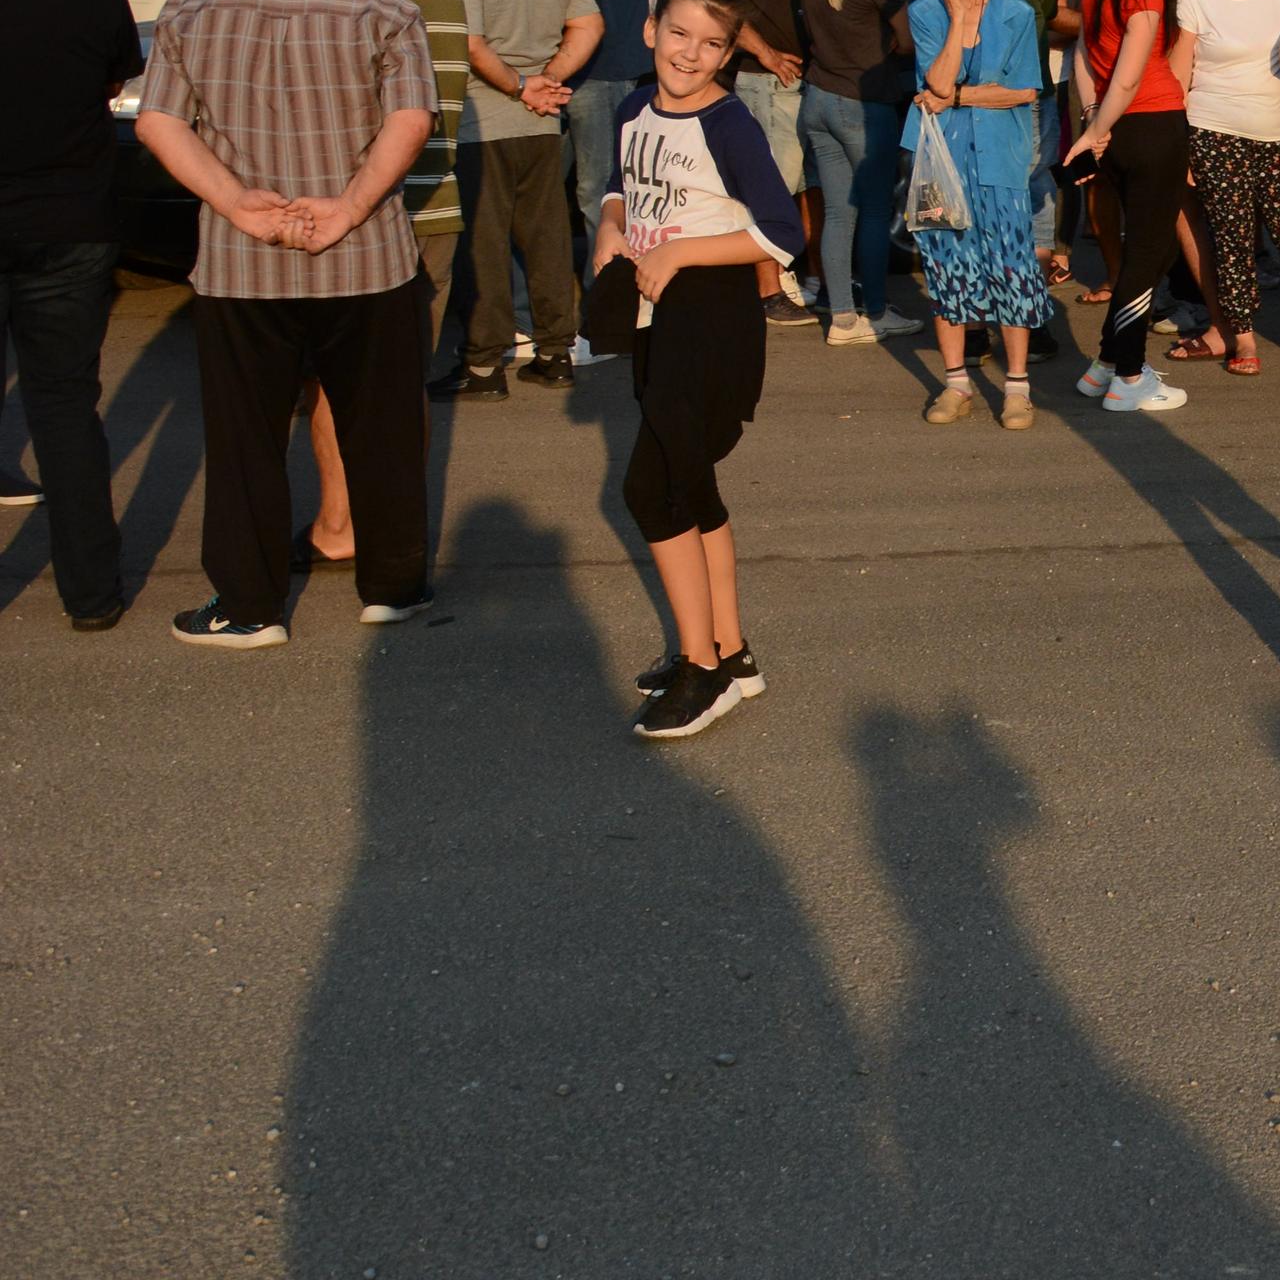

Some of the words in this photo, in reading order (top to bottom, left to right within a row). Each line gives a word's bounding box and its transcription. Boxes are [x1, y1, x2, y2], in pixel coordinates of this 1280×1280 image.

[623, 131, 665, 187] ALL
[661, 148, 697, 172] you
[674, 188, 688, 207] IS
